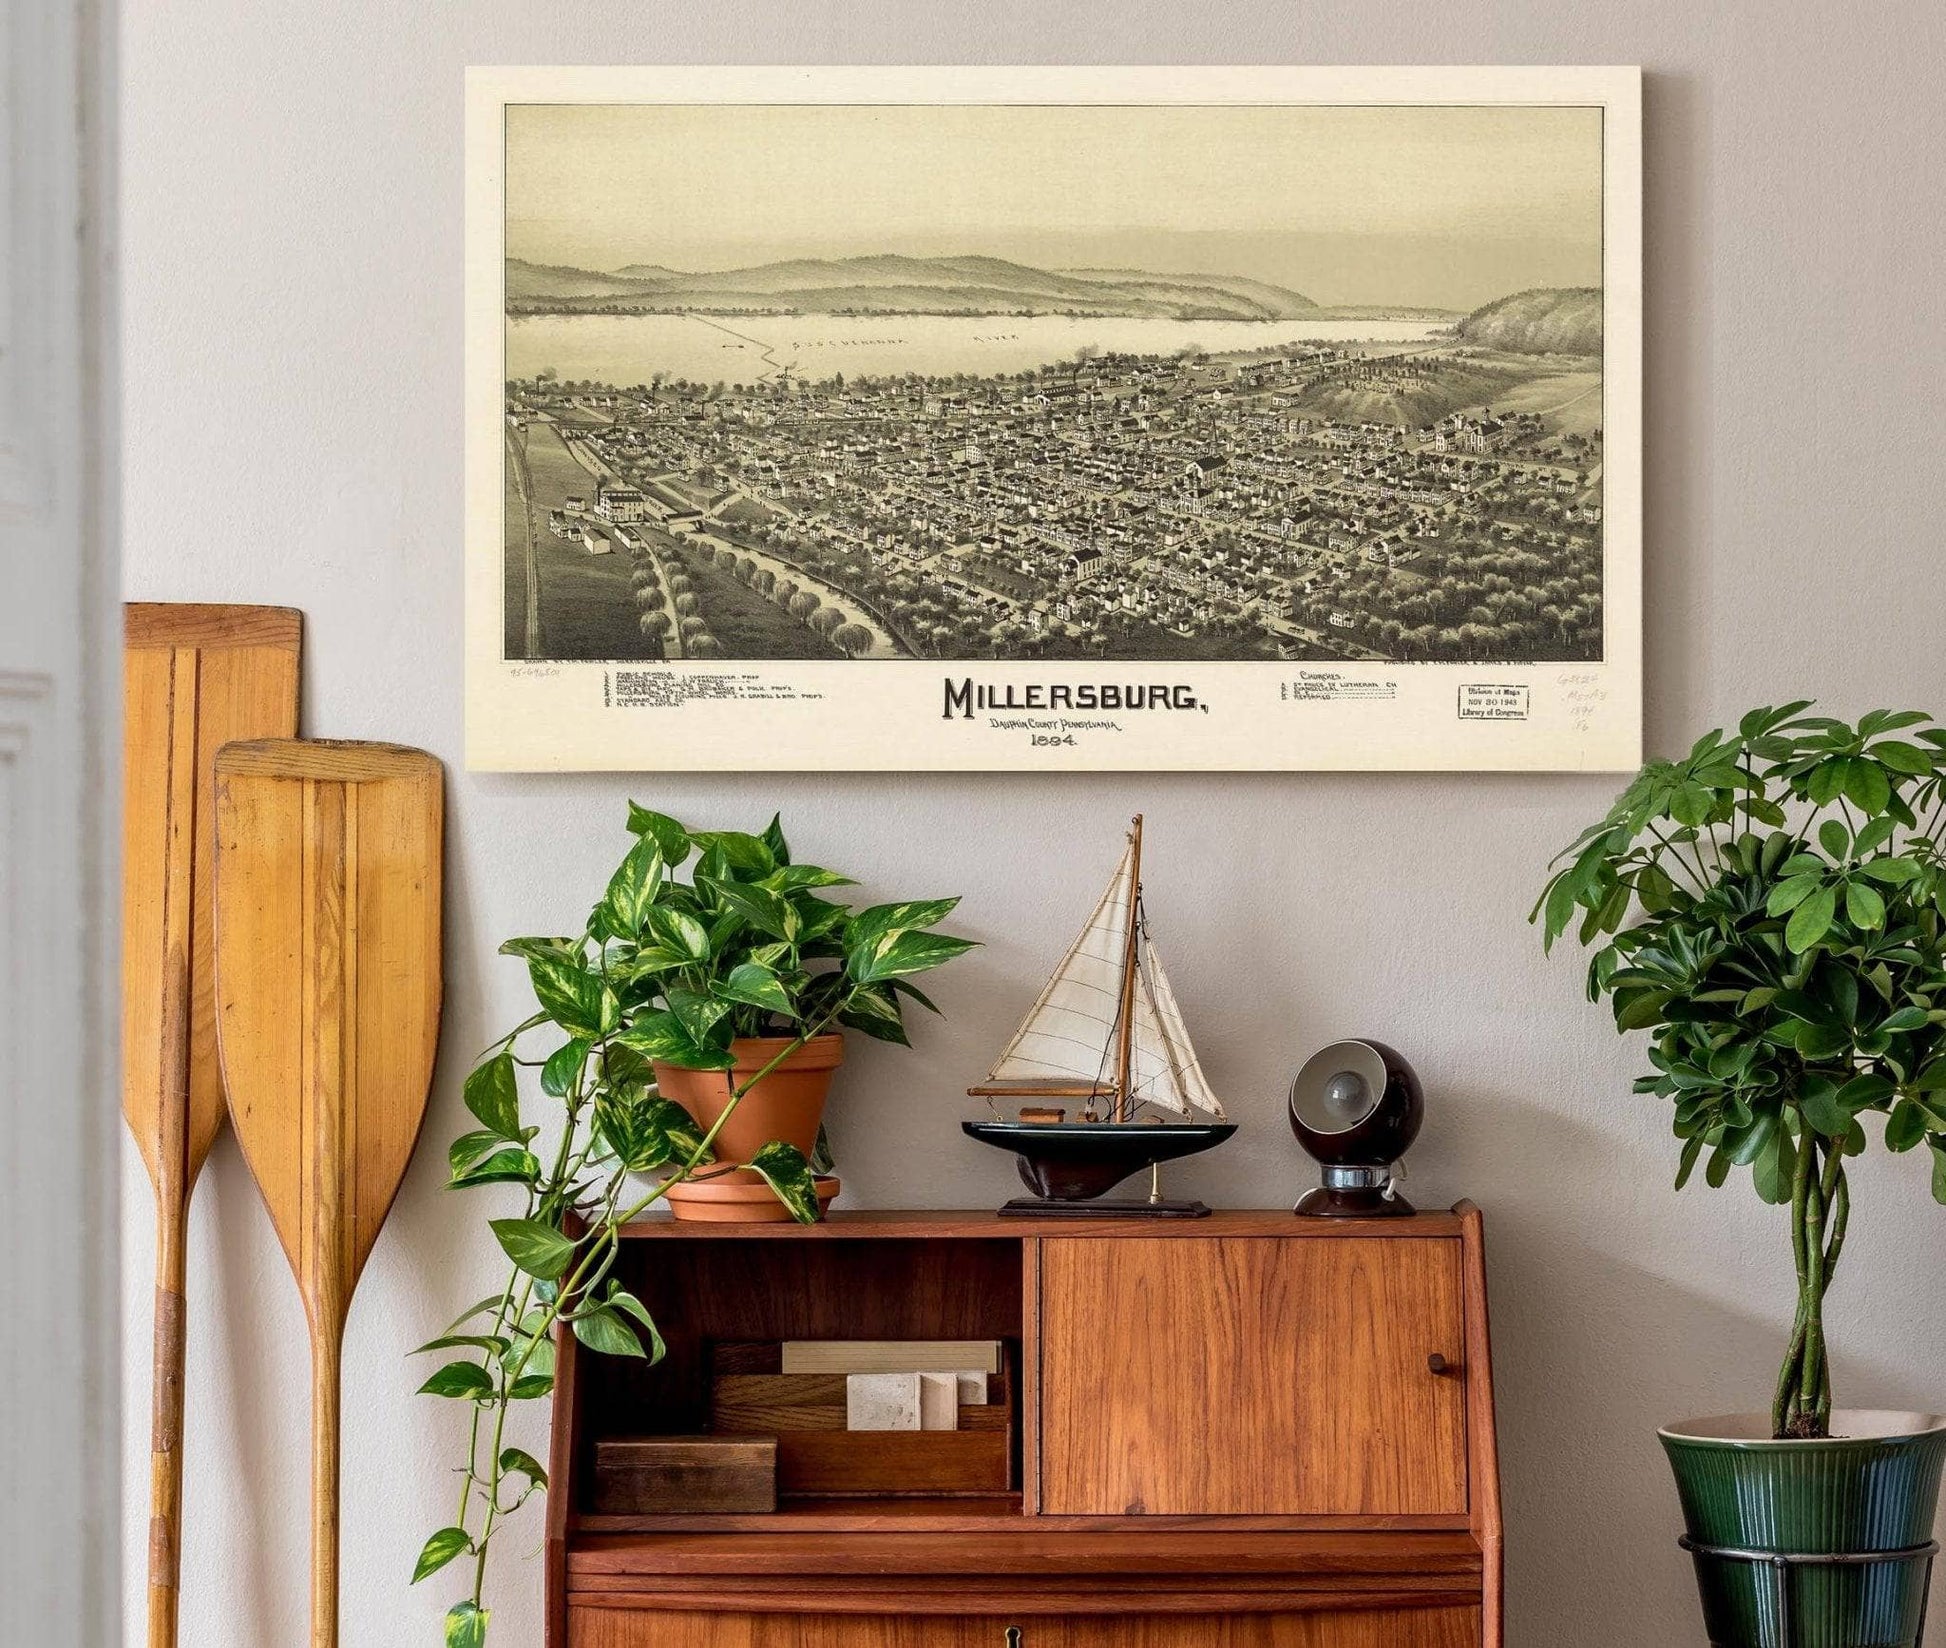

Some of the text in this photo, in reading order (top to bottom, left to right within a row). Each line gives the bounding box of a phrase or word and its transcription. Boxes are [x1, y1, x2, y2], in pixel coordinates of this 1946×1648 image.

[942, 677, 1209, 720] MILLERSBURG,
[1462, 708, 1485, 718] Library
[1486, 709, 1494, 717] of
